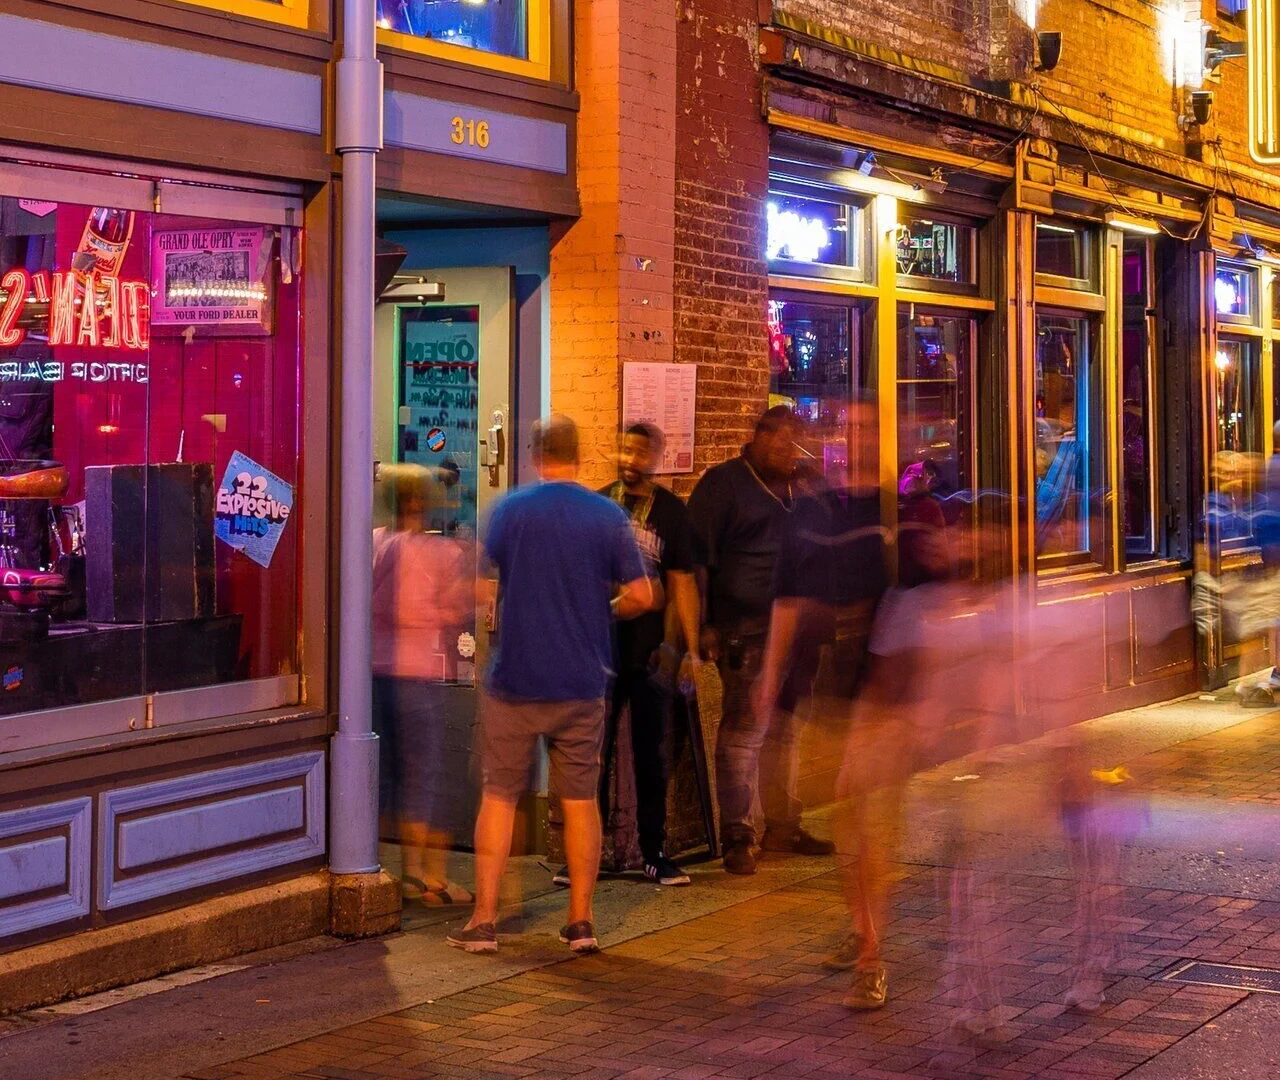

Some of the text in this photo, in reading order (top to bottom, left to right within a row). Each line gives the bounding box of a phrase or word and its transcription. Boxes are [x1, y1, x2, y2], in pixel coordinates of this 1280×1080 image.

[450, 116, 490, 149] 316
[159, 232, 236, 250] GRAND OLE OPRY
[173, 310, 196, 320] YOUR
[198, 310, 220, 320] FORD
[223, 309, 258, 320] DEALER
[237, 472, 268, 499] 22
